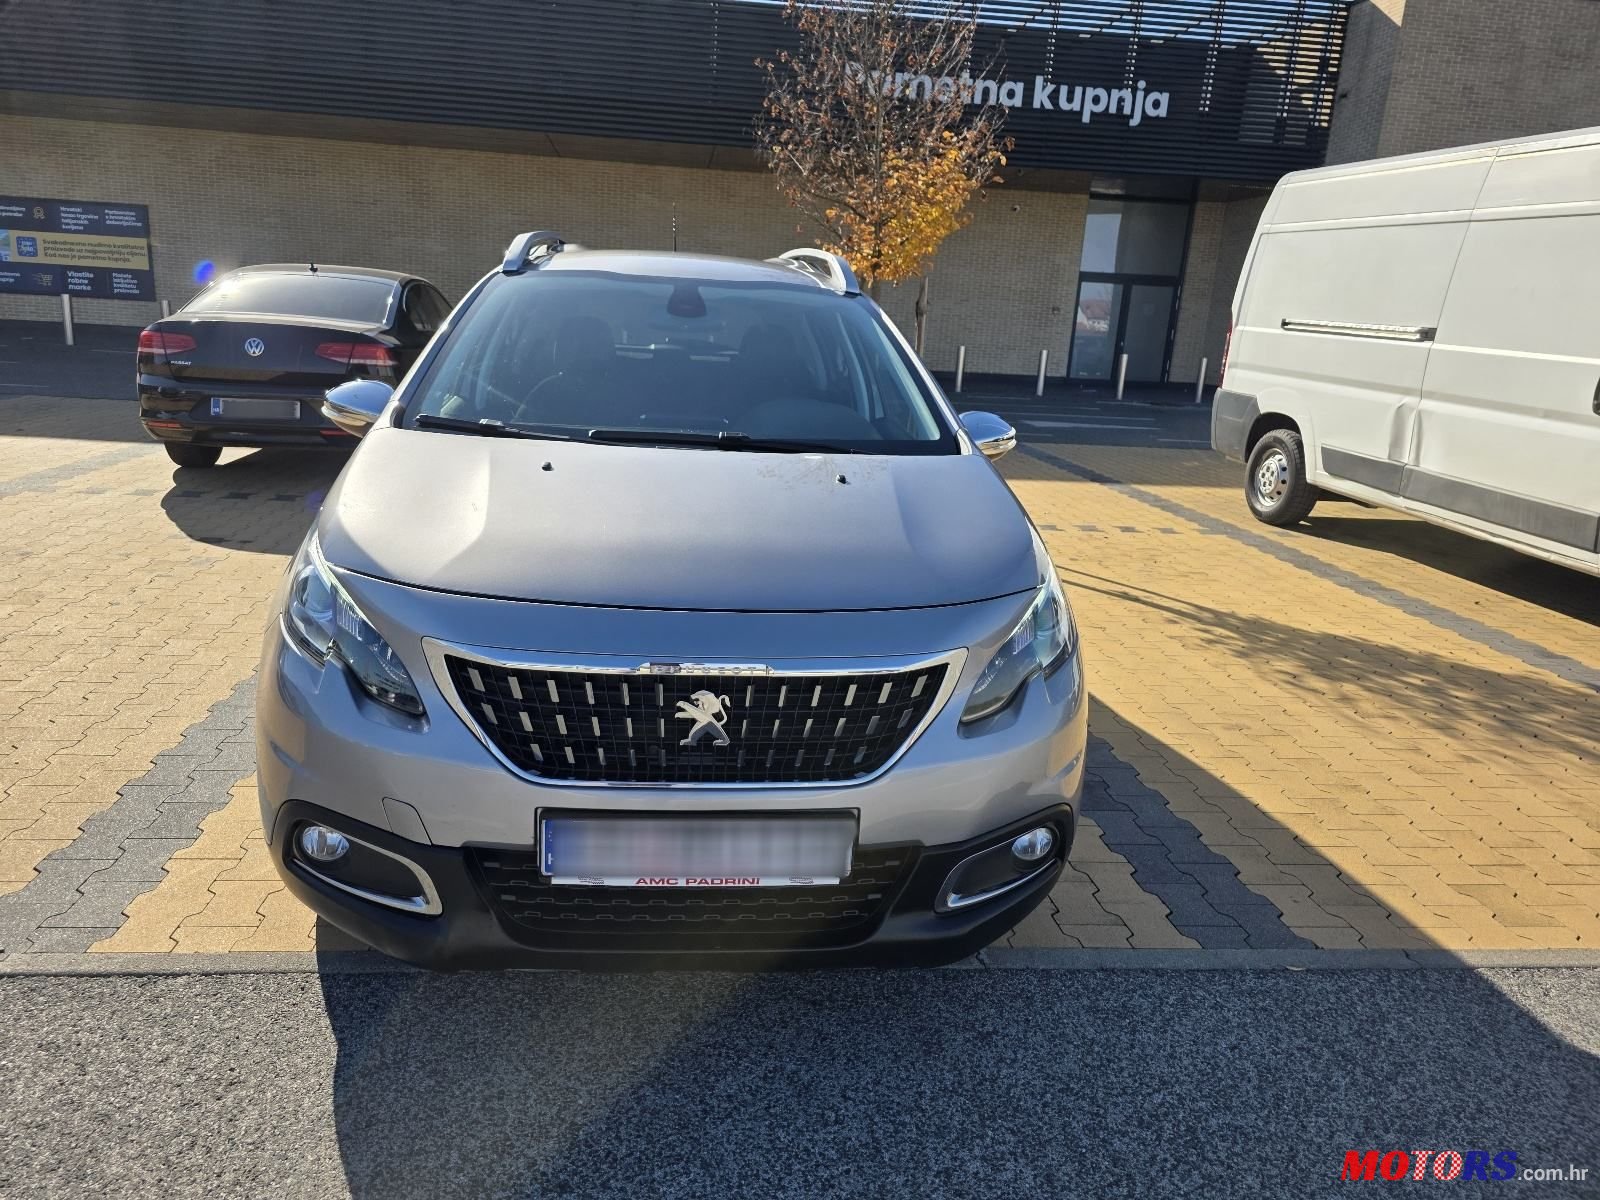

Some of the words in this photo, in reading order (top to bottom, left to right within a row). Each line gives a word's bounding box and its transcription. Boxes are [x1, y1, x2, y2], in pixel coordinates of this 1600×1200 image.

[1032, 75, 1170, 127] kupnja
[635, 877, 679, 885] AMC
[685, 877, 760, 885] PADRINI
